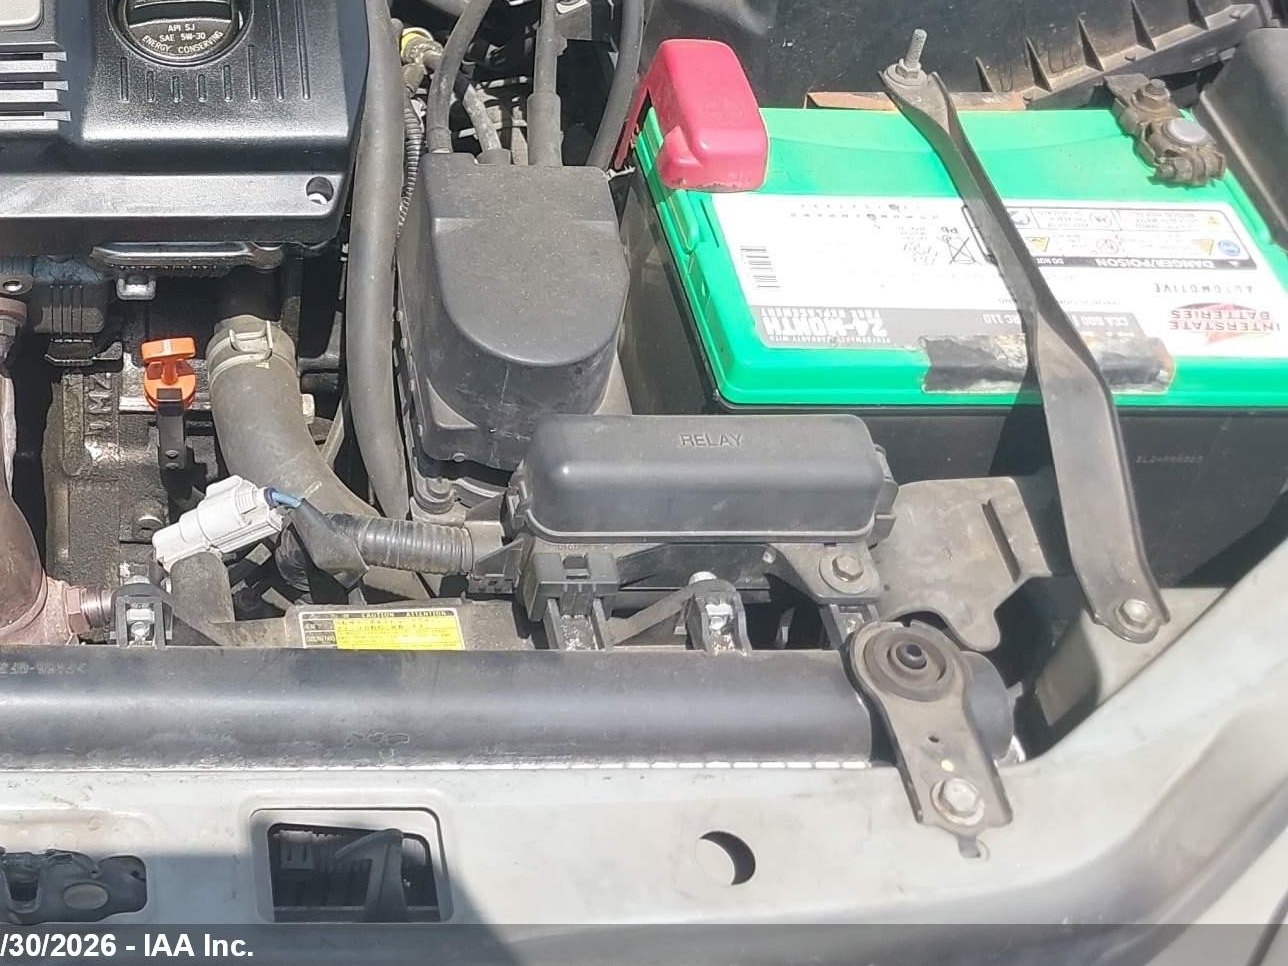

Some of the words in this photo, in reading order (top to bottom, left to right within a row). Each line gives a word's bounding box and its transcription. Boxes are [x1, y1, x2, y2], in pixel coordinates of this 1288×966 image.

[167, 23, 182, 32] API
[184, 23, 196, 32] SJ
[141, 35, 174, 53] ENERGY
[177, 30, 224, 54] CONSERVING
[159, 33, 175, 42] SAE
[180, 32, 206, 41] 5W-30
[1094, 257, 1216, 269] DANGER/POISON
[1152, 282, 1253, 294] AUTOMOTIVE
[1106, 315, 1129, 326] CCA
[1170, 309, 1271, 321] BATTERIES
[762, 317, 888, 338] 24-MONTH
[1168, 321, 1281, 332] INTERSTATE
[682, 434, 741, 447] RELAY
